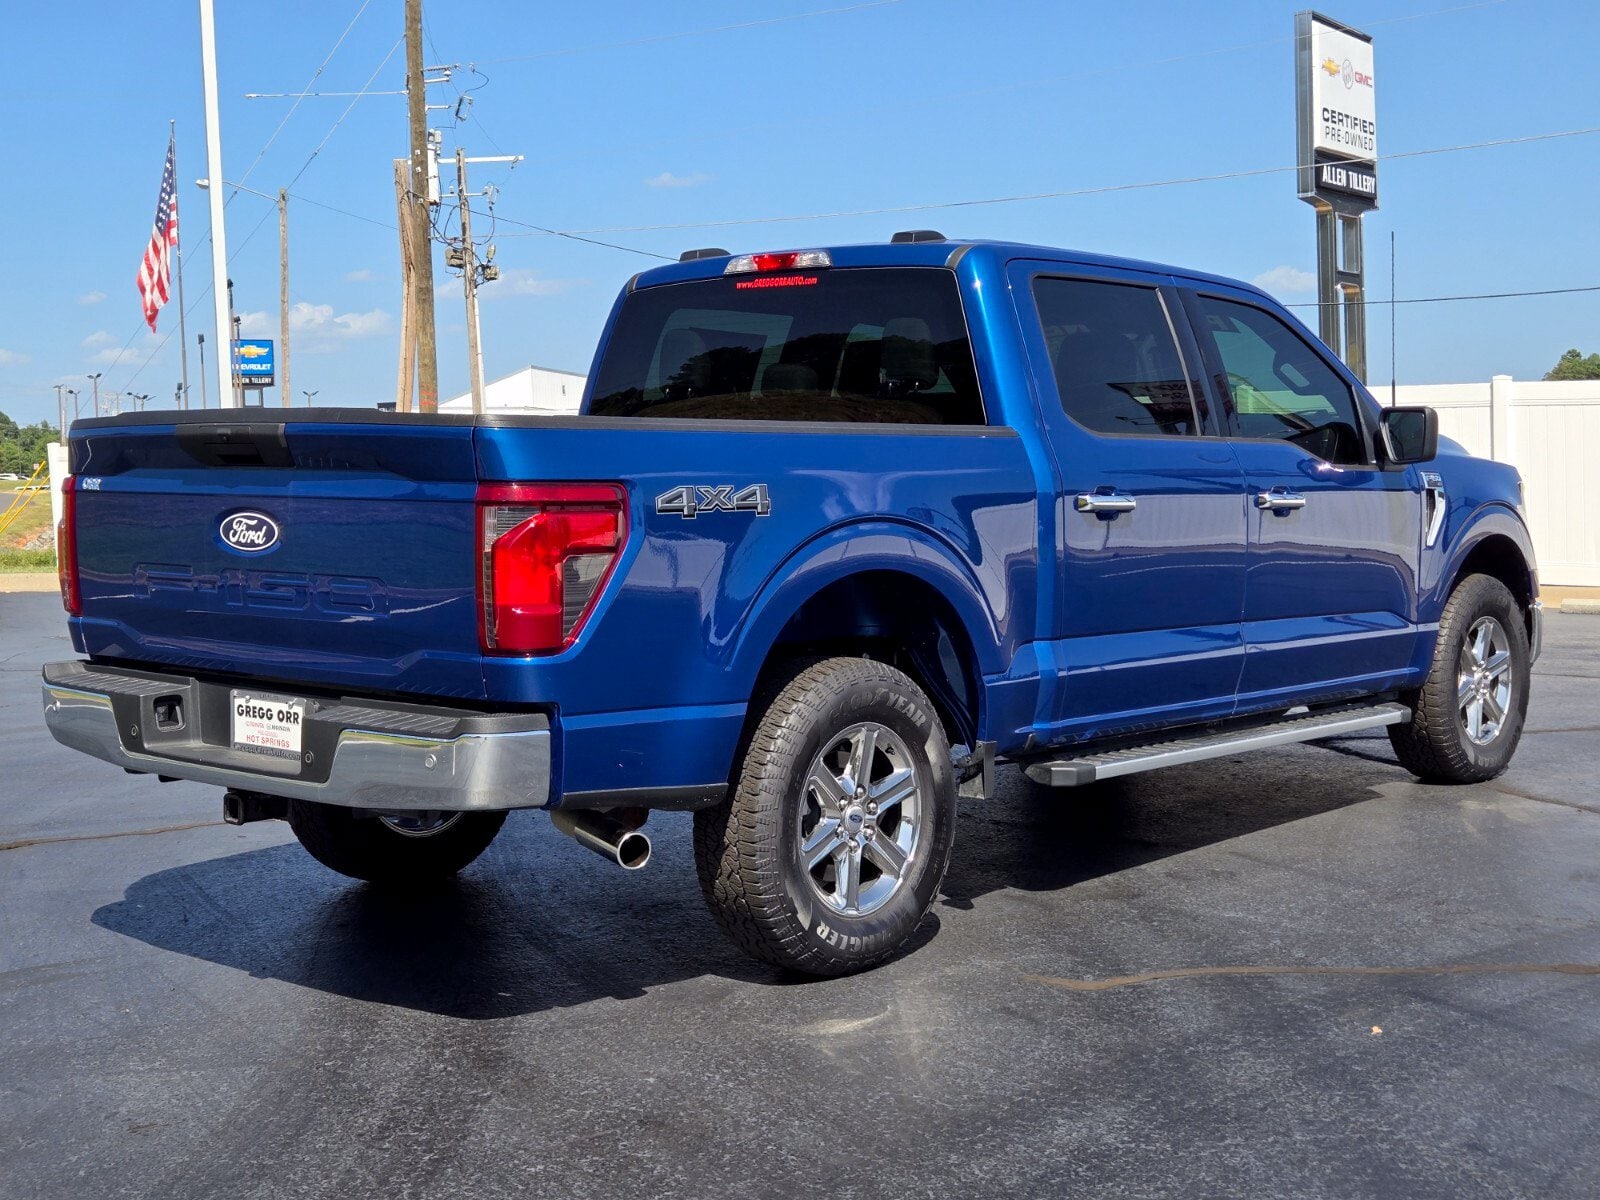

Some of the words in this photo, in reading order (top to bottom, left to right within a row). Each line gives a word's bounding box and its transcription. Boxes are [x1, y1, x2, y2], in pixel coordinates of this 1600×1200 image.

[1355, 71, 1373, 88] GMC
[1322, 107, 1375, 136] CERTIFIED
[1325, 126, 1374, 151] PRE-OWNED
[1322, 165, 1346, 187] ALLEN
[1348, 171, 1375, 194] TILLERY
[229, 516, 268, 546] Ford
[236, 704, 274, 721] GREGG
[277, 709, 300, 725] ORR
[246, 735, 260, 744] HOT
[261, 736, 290, 748] SPRINGS
